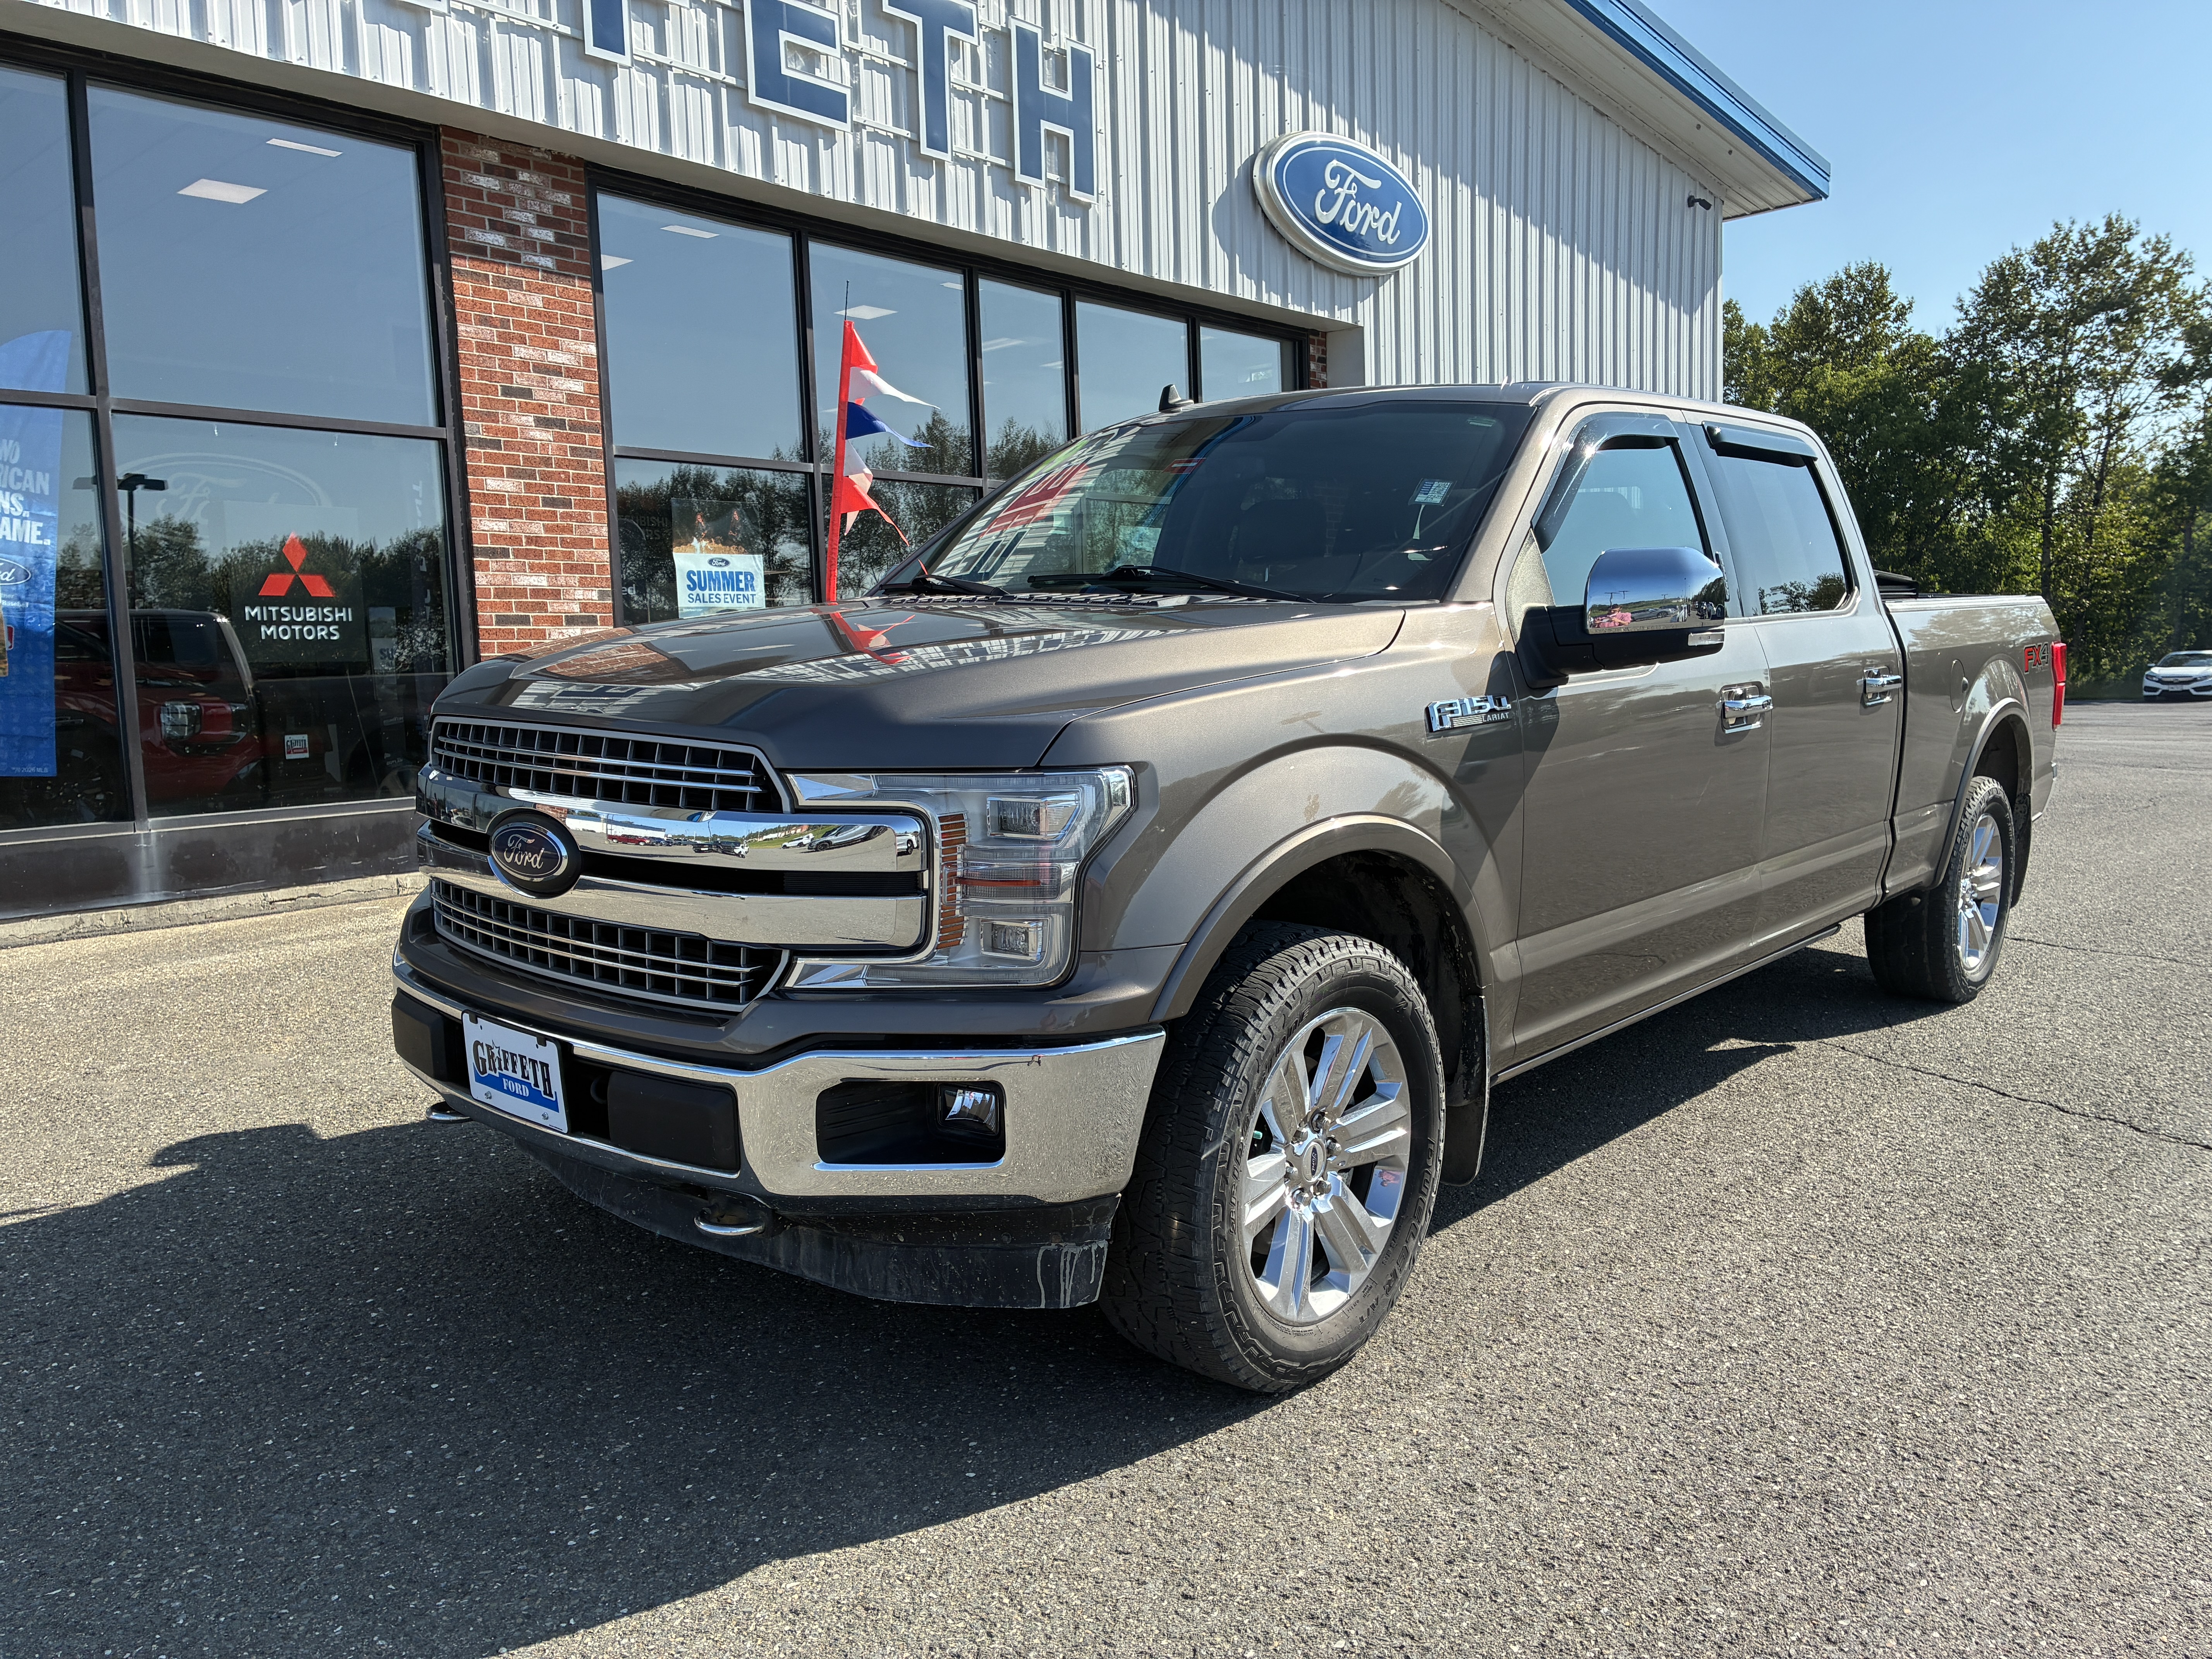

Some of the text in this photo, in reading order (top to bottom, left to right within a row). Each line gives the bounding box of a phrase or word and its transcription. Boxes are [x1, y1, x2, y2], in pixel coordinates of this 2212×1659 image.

[1315, 159, 1402, 245] Ford
[0, 516, 51, 545] AME.
[686, 570, 756, 592] SUMMER
[688, 593, 756, 604] SALES EVENT
[245, 606, 352, 622] MITSUBISHI
[261, 625, 340, 640] MOTORS
[2023, 641, 2049, 675] FX4
[1482, 712, 1510, 722] LARIAT
[503, 834, 545, 869] Ford
[503, 1078, 529, 1097] FORD
